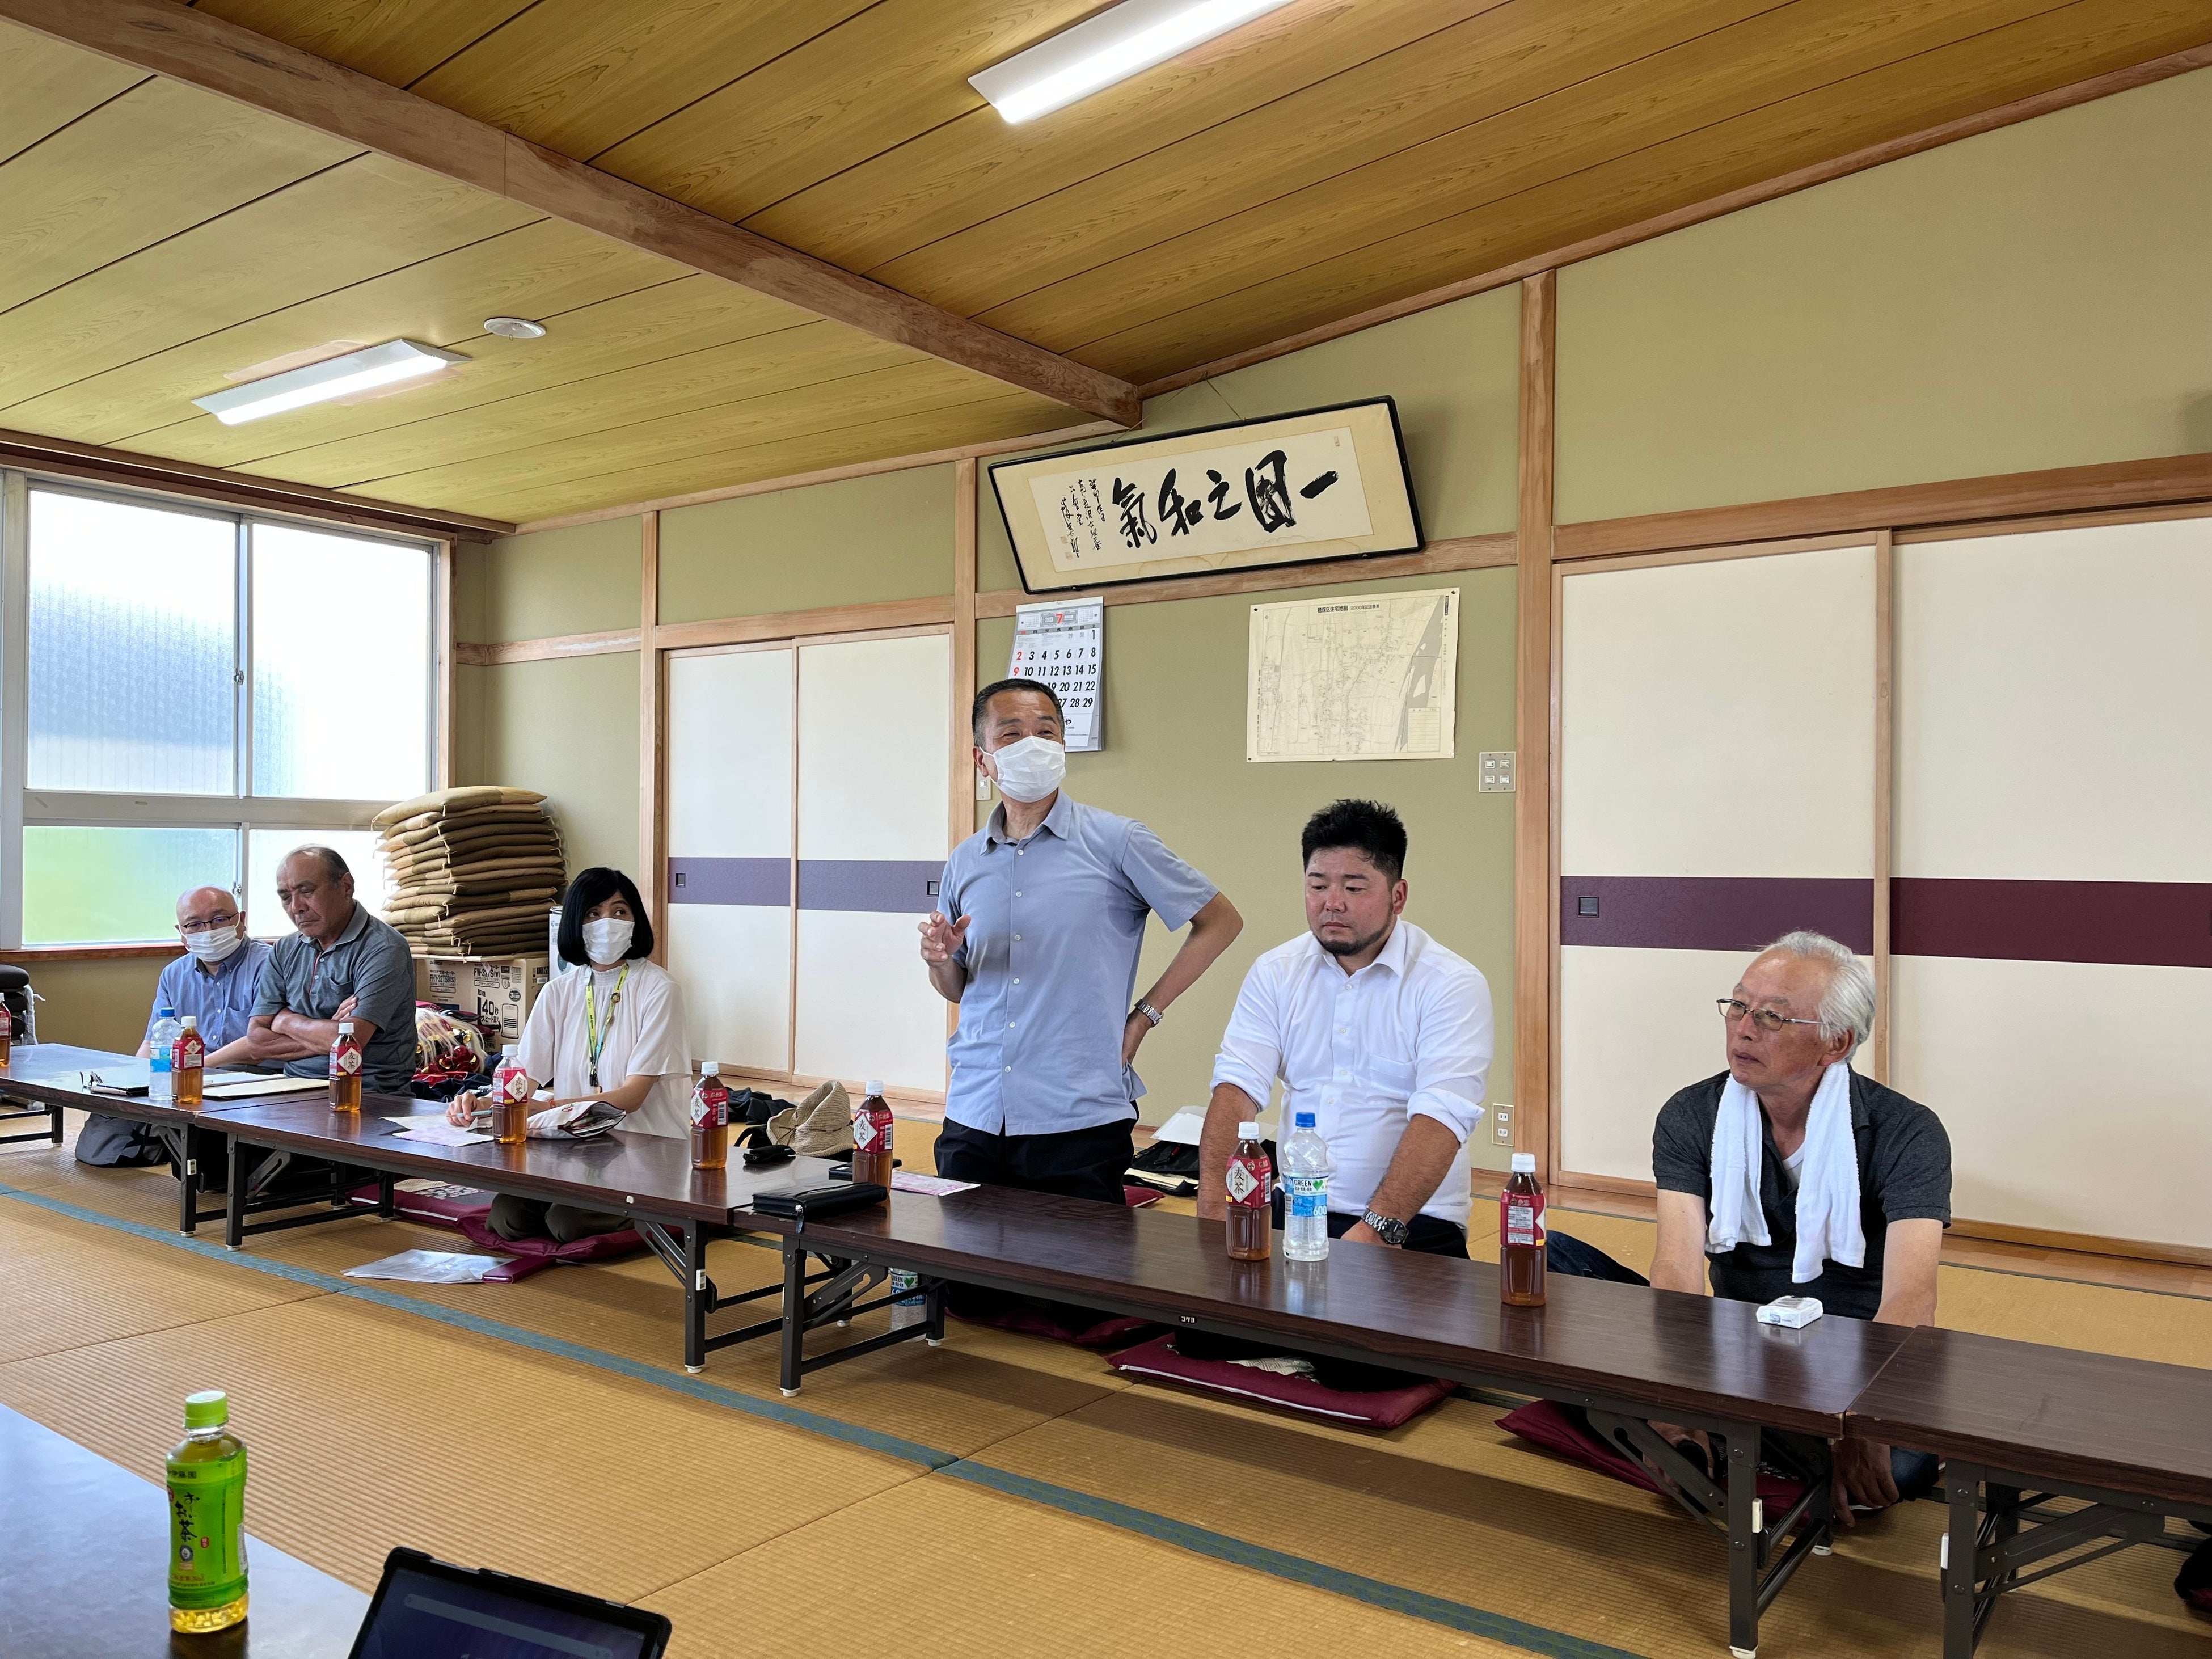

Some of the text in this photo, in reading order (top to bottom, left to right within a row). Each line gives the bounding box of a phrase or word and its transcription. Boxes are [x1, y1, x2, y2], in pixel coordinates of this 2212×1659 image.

[1056, 613, 1064, 624] 7
[1092, 630, 1095, 640] 1
[1016, 647, 1096, 660] 2 3 4 5 6 7 8
[1014, 664, 1096, 676] 9 10 11 12 13 14 15
[1059, 682, 1070, 691] 20
[1073, 682, 1082, 691] 21
[1085, 681, 1095, 691] 22
[1070, 698, 1080, 707] 28
[1082, 698, 1093, 707] 29
[1234, 1167, 1245, 1194] 麦茶
[1313, 1205, 1327, 1216] 600
